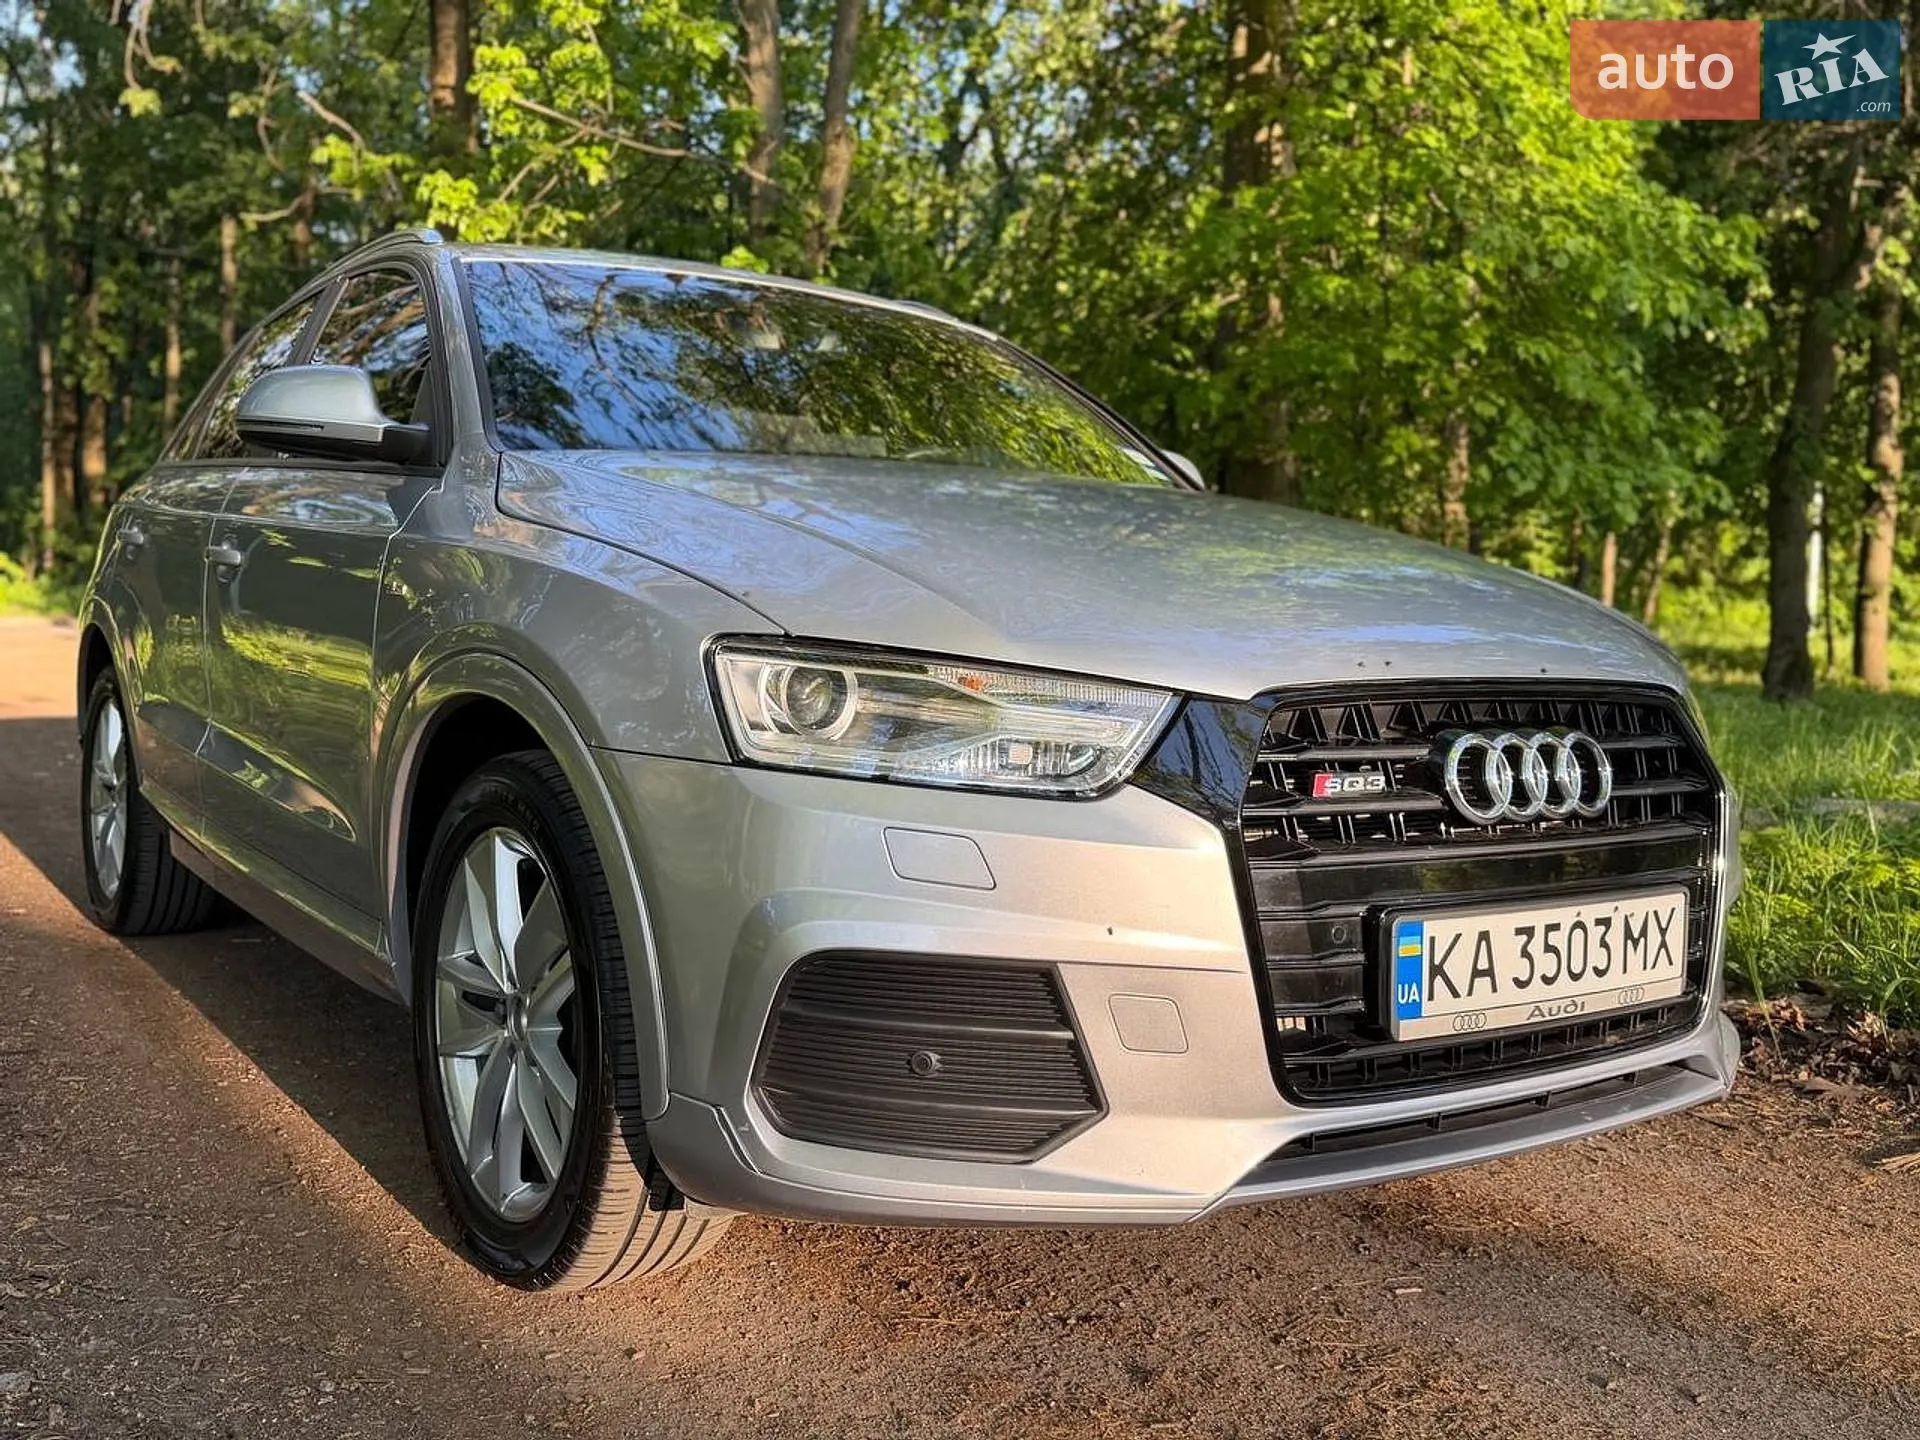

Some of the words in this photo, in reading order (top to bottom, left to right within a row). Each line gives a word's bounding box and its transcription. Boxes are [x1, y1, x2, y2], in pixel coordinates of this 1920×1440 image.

[1427, 930, 1498, 1001] KA
[1512, 916, 1612, 989] 3503
[1622, 907, 1677, 974] MX
[1398, 983, 1420, 1004] UA
[1526, 1001, 1586, 1020] Audi
